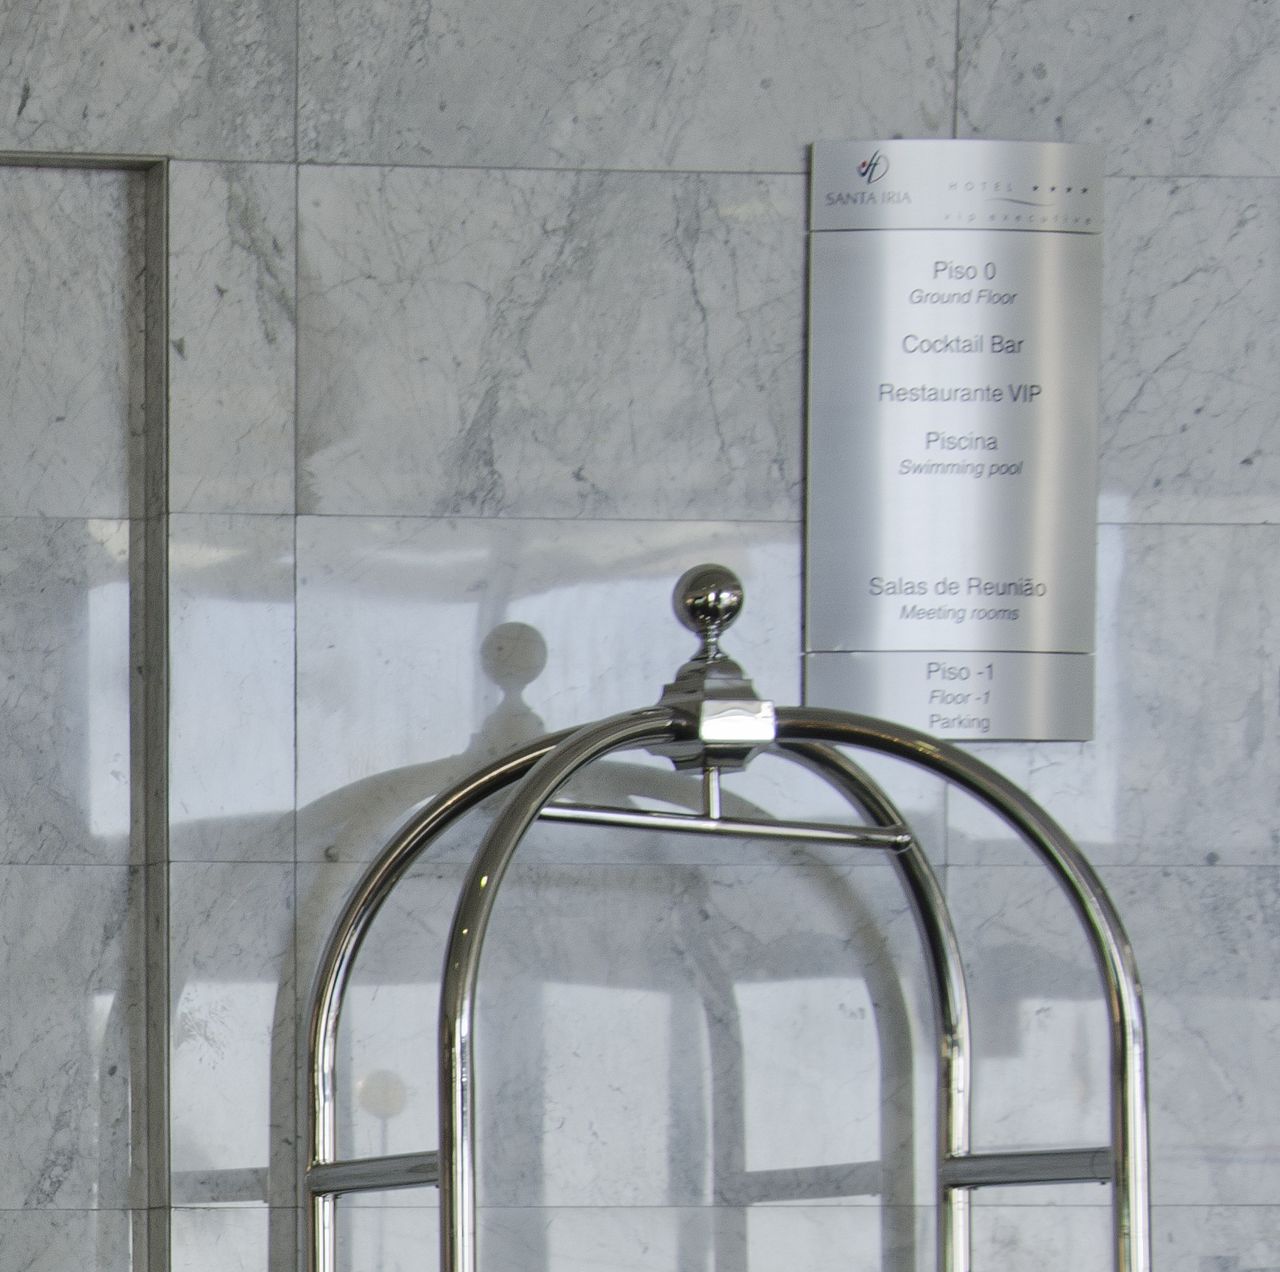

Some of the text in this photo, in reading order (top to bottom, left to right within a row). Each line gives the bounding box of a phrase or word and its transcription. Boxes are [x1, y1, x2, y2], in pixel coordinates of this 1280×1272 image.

[948, 181, 1014, 192] HOTEL
[825, 191, 912, 206] SANTA IRIA
[932, 261, 997, 281] Piso 0
[908, 289, 1018, 305] Ground Floor
[902, 334, 1024, 354] Cocktail Bar
[879, 383, 1043, 402] Restaurante VIP
[925, 432, 998, 450] Piscina
[898, 460, 1023, 479] Swimming pool
[869, 577, 1047, 597] Salas de Reunião
[900, 605, 1020, 623] Meeting rooms
[926, 662, 994, 680] Piso -1
[928, 689, 991, 704] Floor -1
[928, 712, 991, 733] Parking
